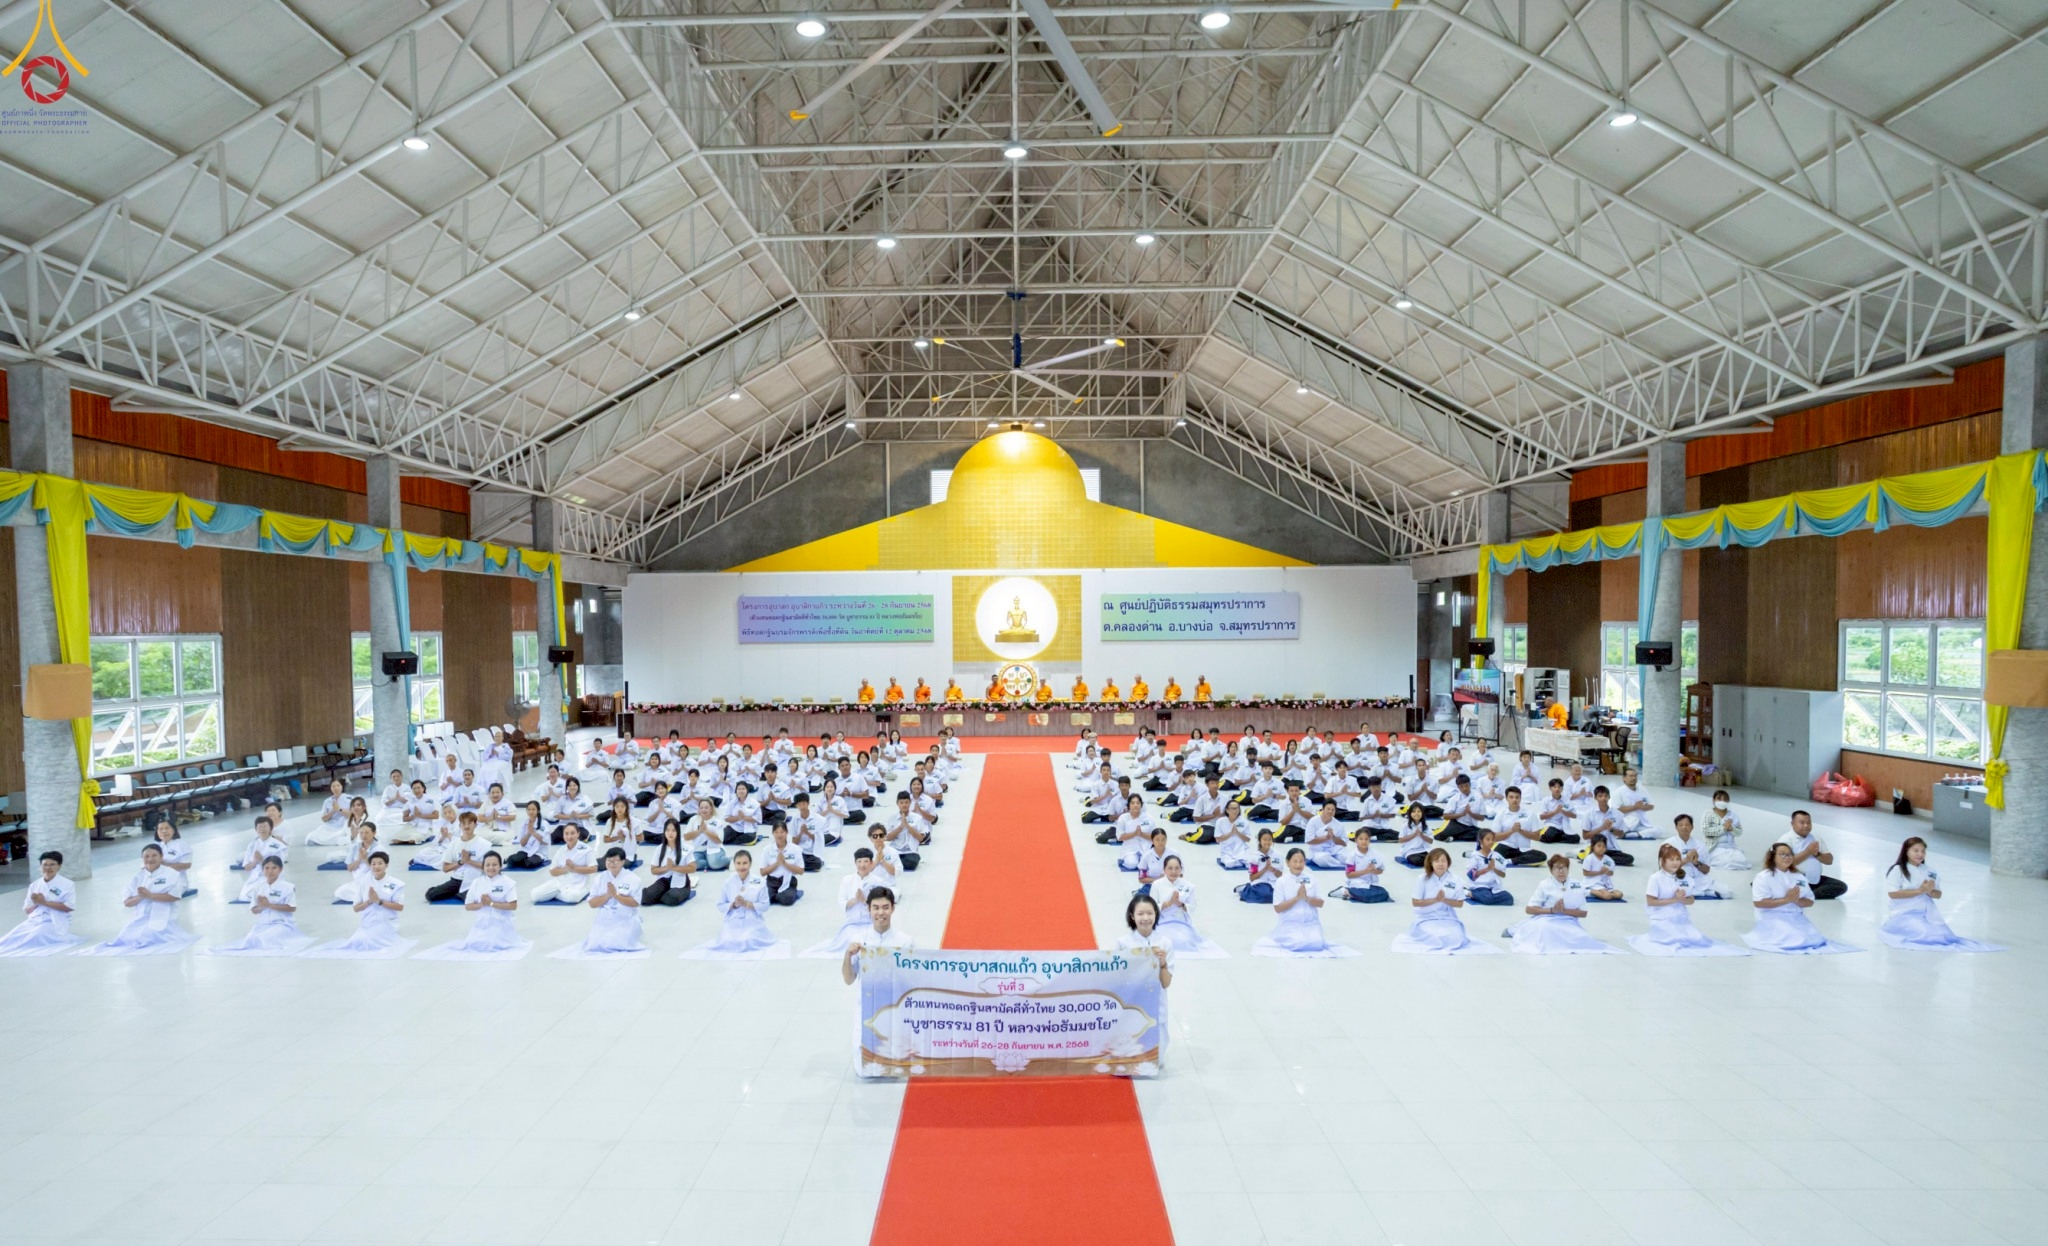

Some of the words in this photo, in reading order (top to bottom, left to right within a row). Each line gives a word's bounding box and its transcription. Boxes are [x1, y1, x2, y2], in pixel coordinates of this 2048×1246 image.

[1103, 601, 1114, 611] ณ
[1119, 598, 1267, 615] ศูนย์ปฏิบัติธรรมสมุทรปราการ
[1168, 619, 1214, 632] อ.บางบ่อ
[1219, 620, 1297, 636] จ.สมุทรปราการ
[893, 952, 1037, 979] โครงการอุบาสกแก้ว
[1041, 955, 1129, 980] อุบาสิกาแก้ว
[997, 978, 1017, 995] รุ่นที่
[1018, 983, 1025, 991] 3
[904, 997, 1056, 1016] ตัวแทนทอดกฐินสามัคคีทั่วไทย
[1058, 1002, 1101, 1014] 30,000
[1103, 999, 1118, 1011] วัด
[975, 1022, 990, 1033] 81
[993, 1018, 1005, 1034] ปี
[932, 1037, 980, 1049] ระหว่างวันที่
[981, 1042, 1010, 1050] 26-28
[1011, 1041, 1046, 1051] กันยายน
[1065, 1040, 1090, 1049] 2568
